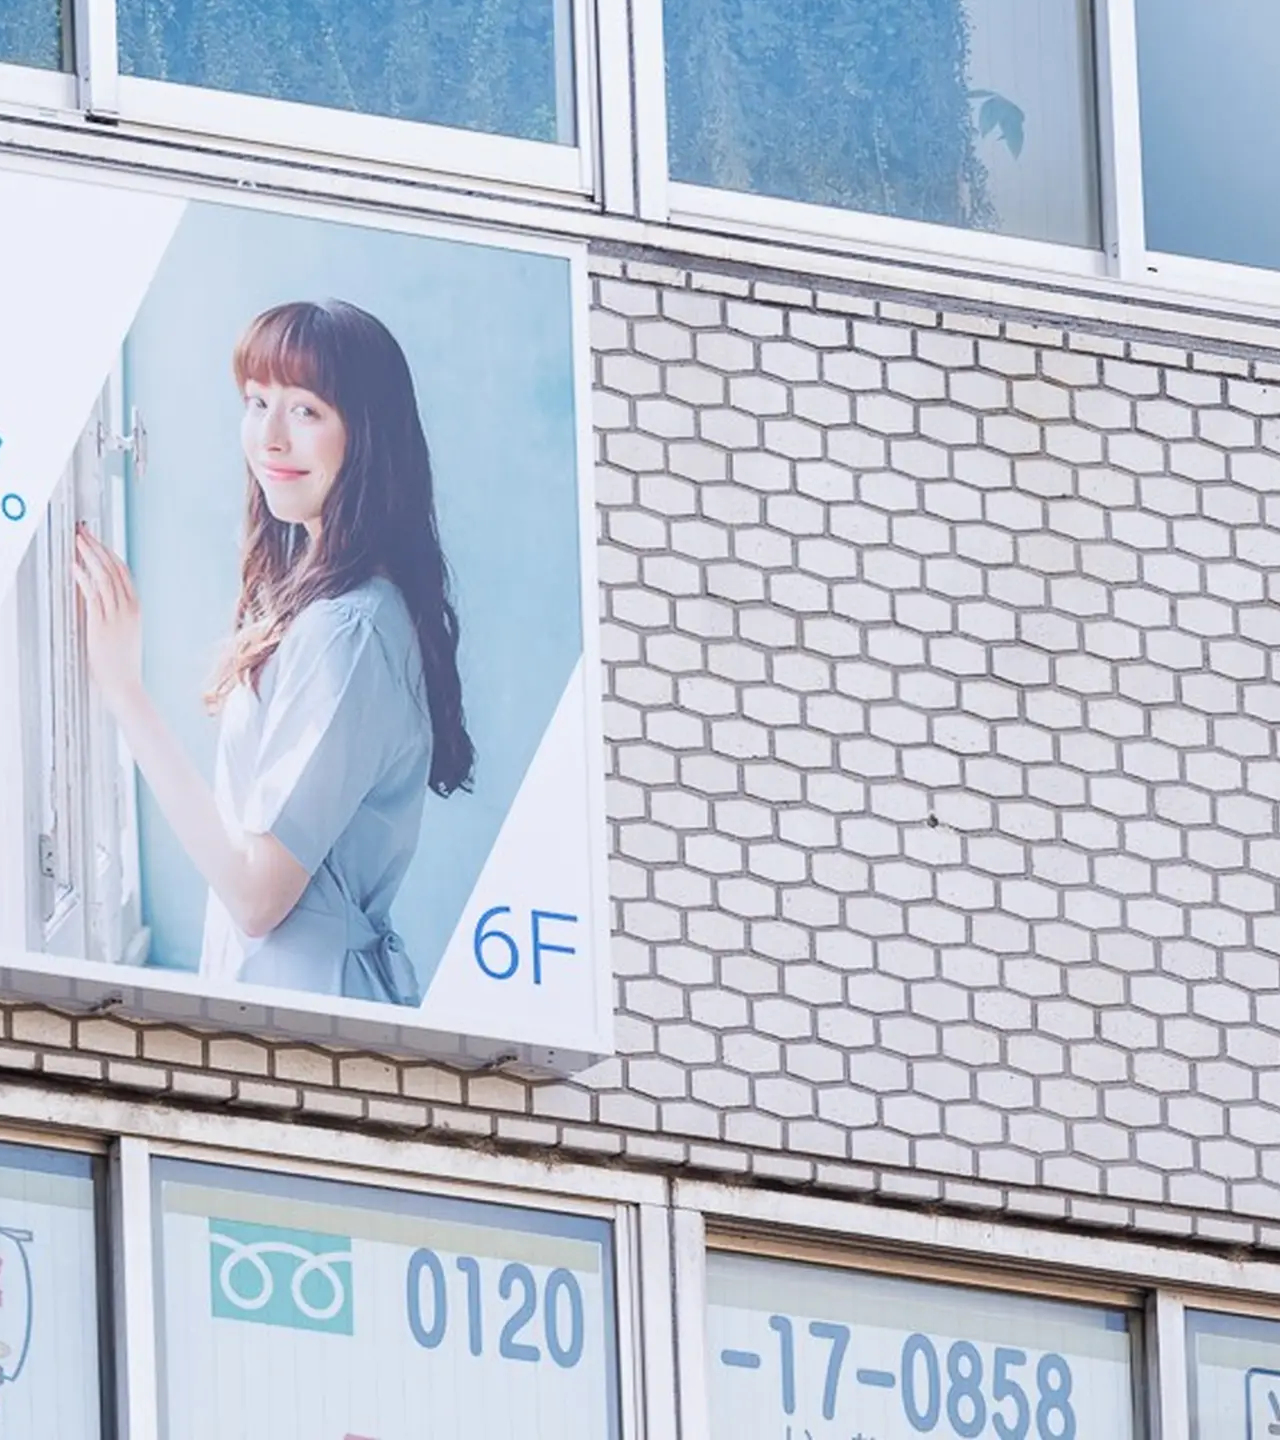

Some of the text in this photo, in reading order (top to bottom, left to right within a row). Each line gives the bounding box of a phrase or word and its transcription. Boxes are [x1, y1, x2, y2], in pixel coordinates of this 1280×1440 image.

[473, 905, 579, 985] 6F
[406, 1246, 1077, 1440] 0120 -17-0858
